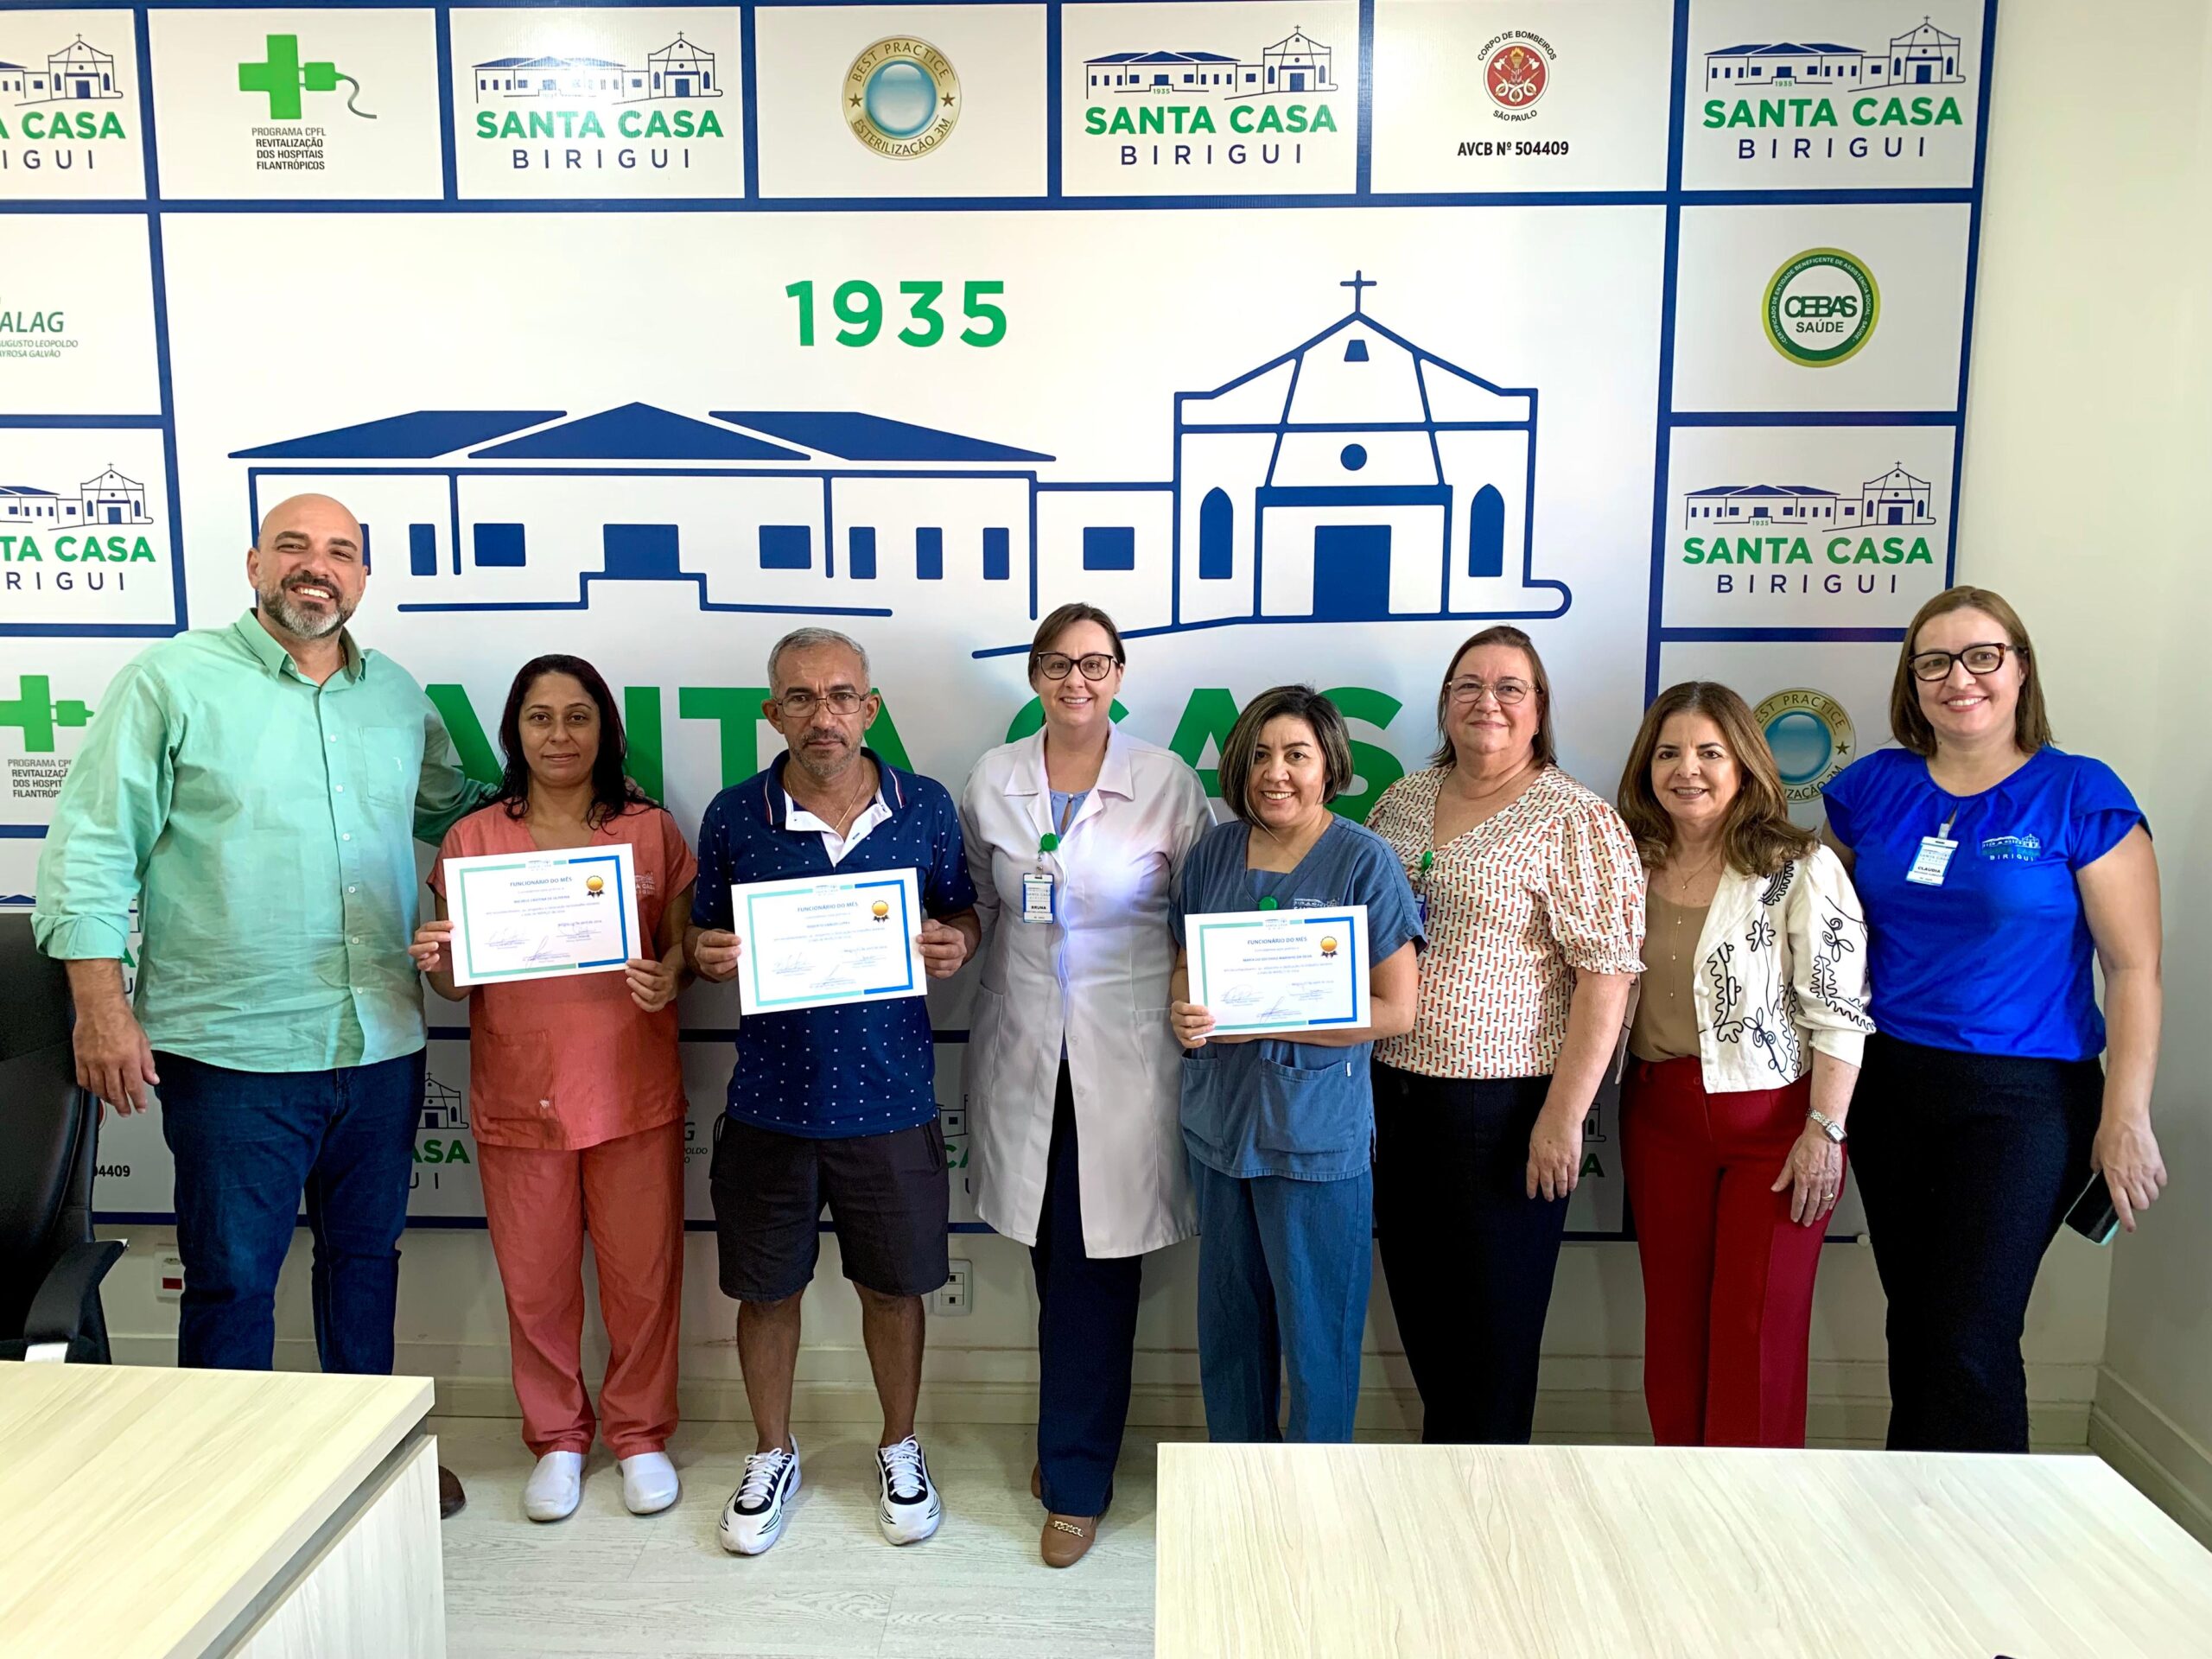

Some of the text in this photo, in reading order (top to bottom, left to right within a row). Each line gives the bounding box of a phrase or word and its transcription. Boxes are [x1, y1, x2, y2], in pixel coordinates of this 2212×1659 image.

[1478, 30, 1557, 61] CORPO DE BOMBEIROS
[852, 42, 950, 83] BEST PRACTICE
[1085, 105, 1338, 136] SANTA CASA
[1493, 110, 1537, 122] SÃO PAULO
[1703, 97, 1963, 128] SANTA CASA
[22, 111, 126, 139] CASA
[251, 127, 327, 137] PROGRAMA CPFL
[476, 110, 724, 139] SANTA CASA
[256, 137, 323, 149] REVITALIZAÇÃO
[854, 118, 950, 156] ESTERILIZAÇÃO 3M
[277, 149, 323, 158] HOSPITAIS
[1121, 143, 1301, 165] BIRIGUI
[1458, 142, 1493, 156] AVCB
[1516, 141, 1569, 156] 504409
[1738, 137, 1924, 159] BIRIGUI
[257, 159, 325, 170] FILANTRÓPICOS
[513, 149, 689, 169] BIRIGUI
[1775, 270, 1795, 295] ENTIDADE
[1795, 257, 1834, 270] BENEFICENTE
[785, 280, 1007, 348] 1935
[1784, 295, 1858, 318] CEBAS
[1796, 319, 1844, 333] SAÚDE
[29, 348, 61, 358] GALVÃO
[54, 536, 156, 562] CASA
[1682, 537, 1934, 564] SANTA CASA
[6, 572, 124, 590] RIGUI
[1717, 575, 1897, 594] BIRIGUI
[1755, 694, 1846, 728] EST PRACTICE
[8, 759, 56, 767] PROGRAMA
[13, 788, 61, 798] FILANTRÓP
[798, 904, 836, 912] FUNCIONÁRIO
[94, 1165, 130, 1177] 4409
